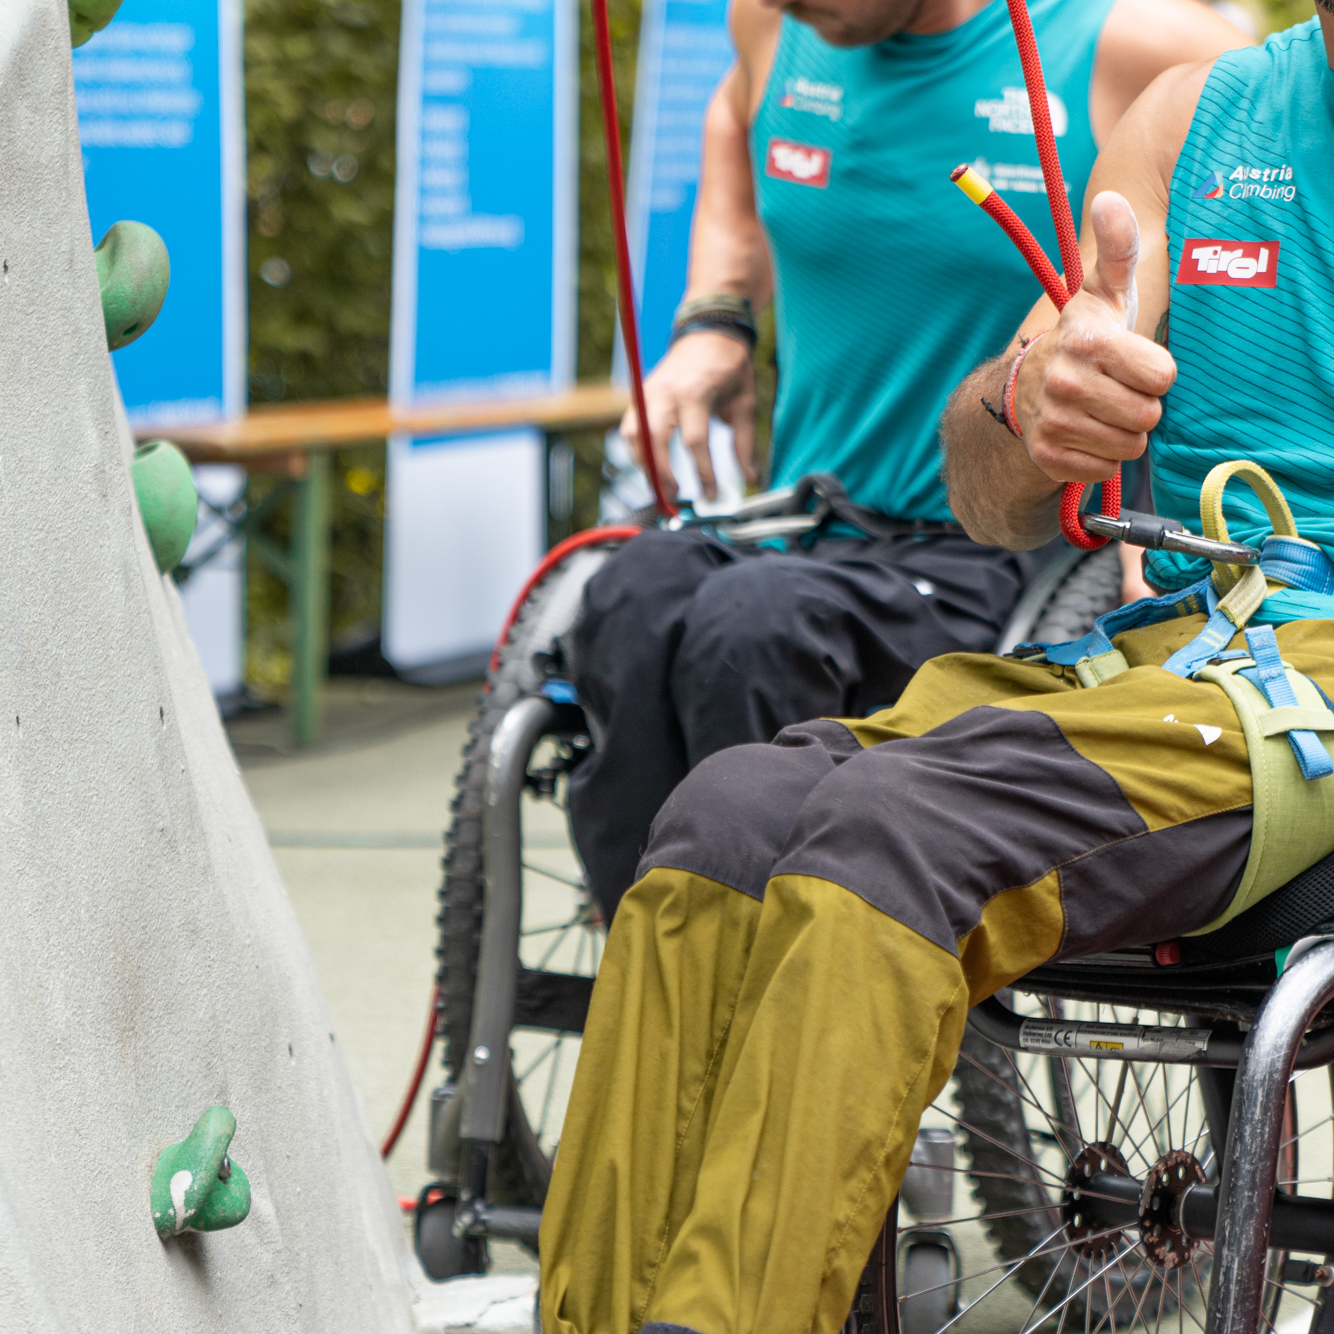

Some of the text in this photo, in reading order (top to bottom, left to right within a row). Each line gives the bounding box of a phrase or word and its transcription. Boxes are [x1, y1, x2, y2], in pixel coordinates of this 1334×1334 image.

[1228, 164, 1293, 182] Austria
[1229, 183, 1296, 202] Climbing
[1191, 246, 1269, 279] Tirol
